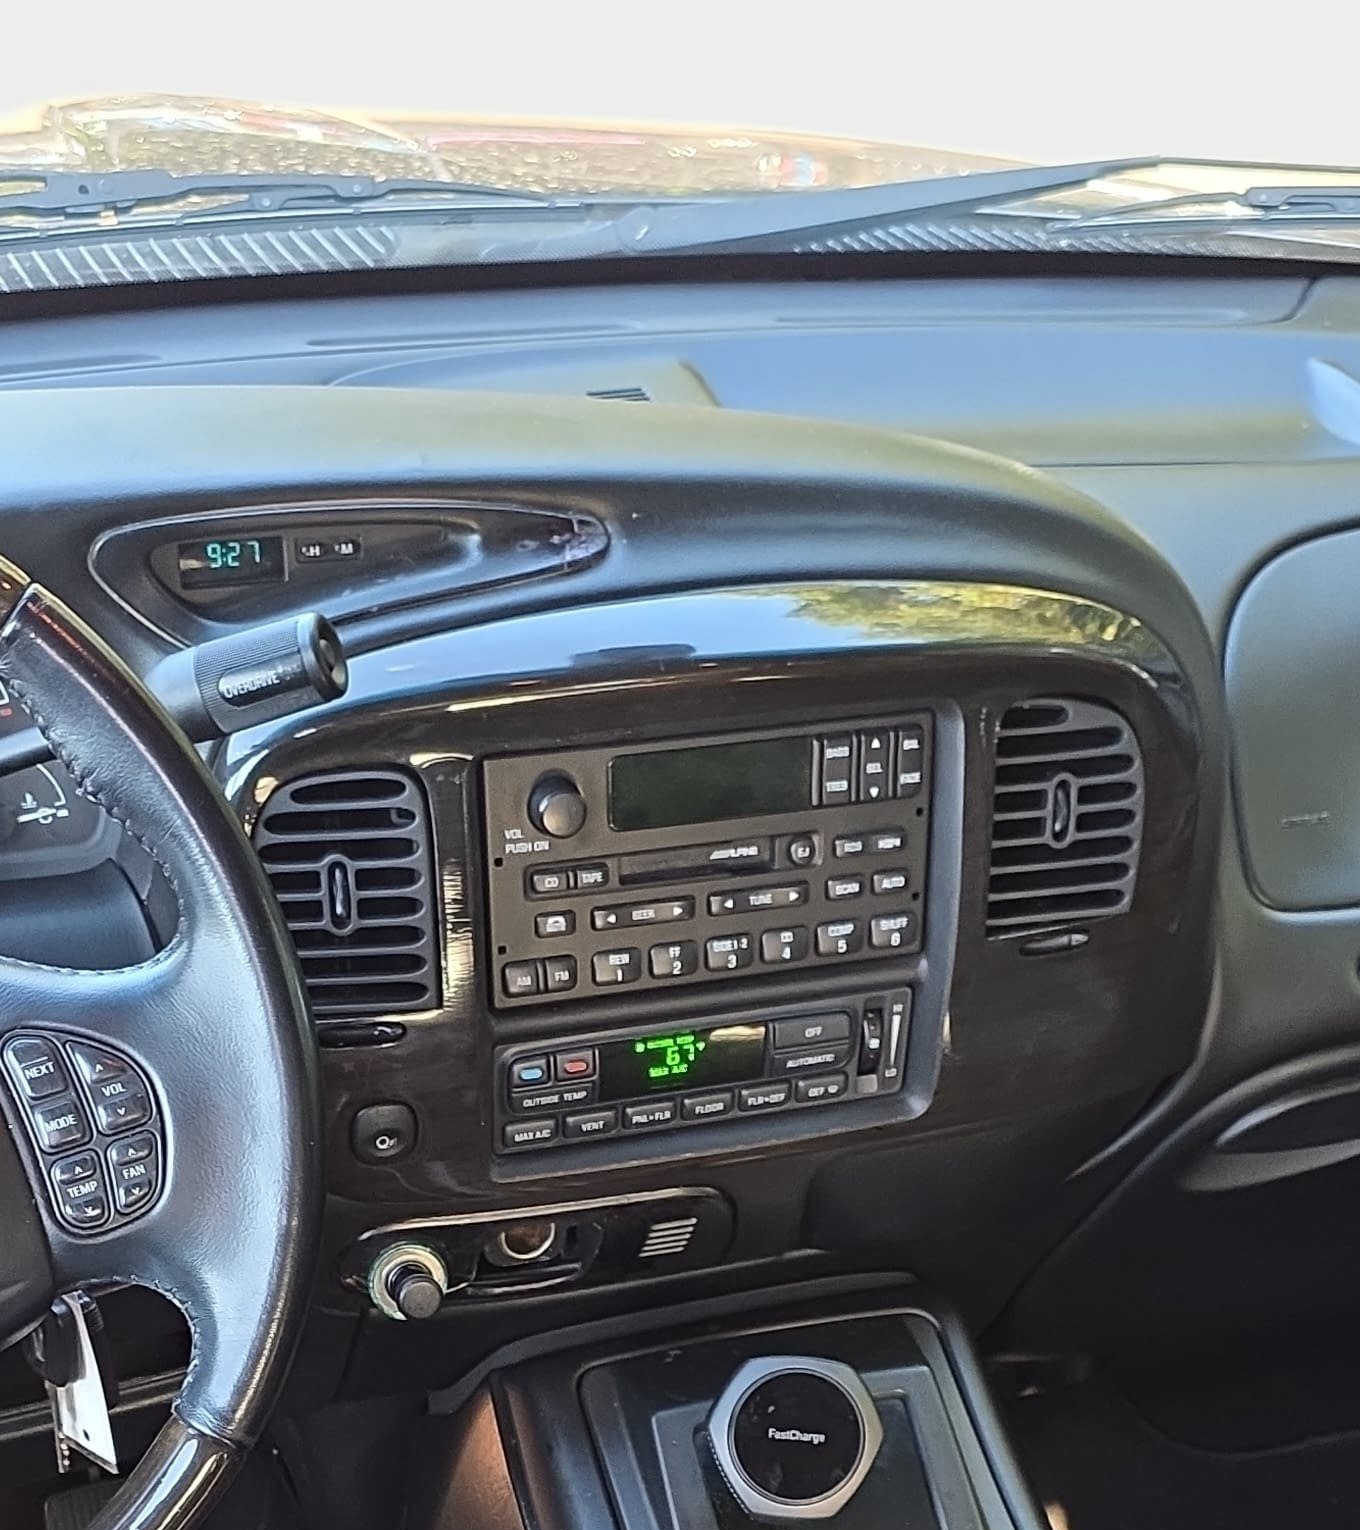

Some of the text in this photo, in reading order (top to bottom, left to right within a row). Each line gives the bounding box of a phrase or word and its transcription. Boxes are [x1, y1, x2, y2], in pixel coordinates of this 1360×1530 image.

[207, 540, 260, 568] 9:27
[223, 671, 281, 699] OVERDRIVE
[504, 829, 524, 840] VOL
[582, 872, 604, 884] TAPE
[838, 939, 847, 953] 5
[890, 932, 901, 946] 6
[782, 947, 791, 960] 4
[672, 961, 682, 974] 2
[727, 954, 737, 969] 3
[805, 1026, 823, 1038] OFF
[25, 1062, 55, 1080] NEXT
[101, 1083, 126, 1097] VOL
[523, 1091, 588, 1108] OUTSIDE TEMP
[45, 1115, 78, 1132] MODE
[123, 1164, 146, 1180] FAN
[67, 1181, 98, 1198] TEMP
[768, 1427, 826, 1445] FastCharge
